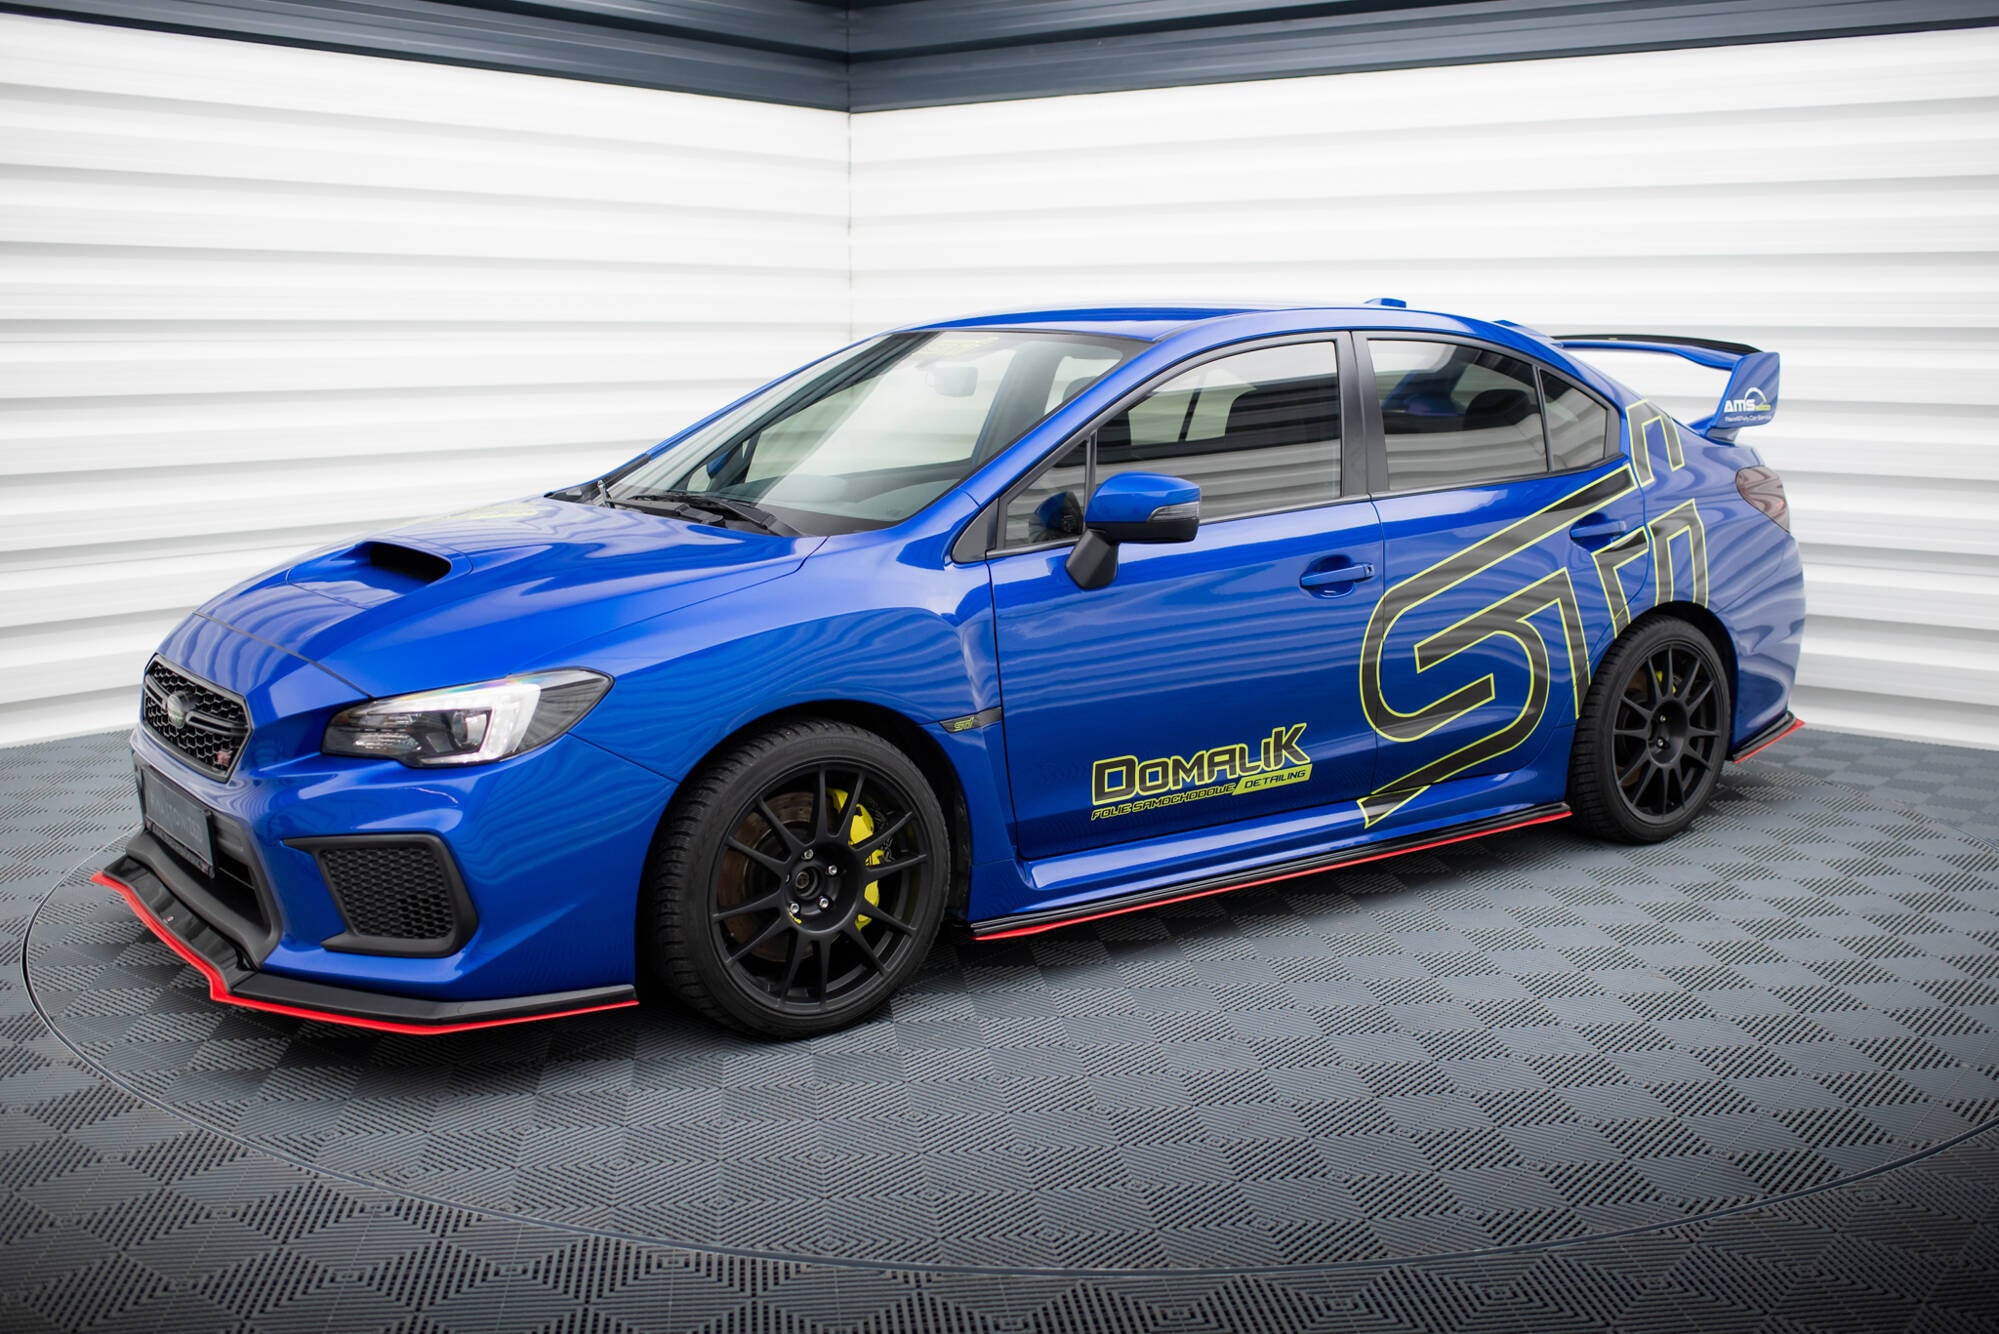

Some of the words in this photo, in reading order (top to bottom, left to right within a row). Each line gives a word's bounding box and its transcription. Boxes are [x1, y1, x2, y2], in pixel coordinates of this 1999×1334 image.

[1724, 399, 1755, 413] AMS
[1091, 803, 1132, 821] FOLIE
[1132, 782, 1237, 813] SAMOCHODOWE
[1243, 769, 1307, 790] DETAILING
